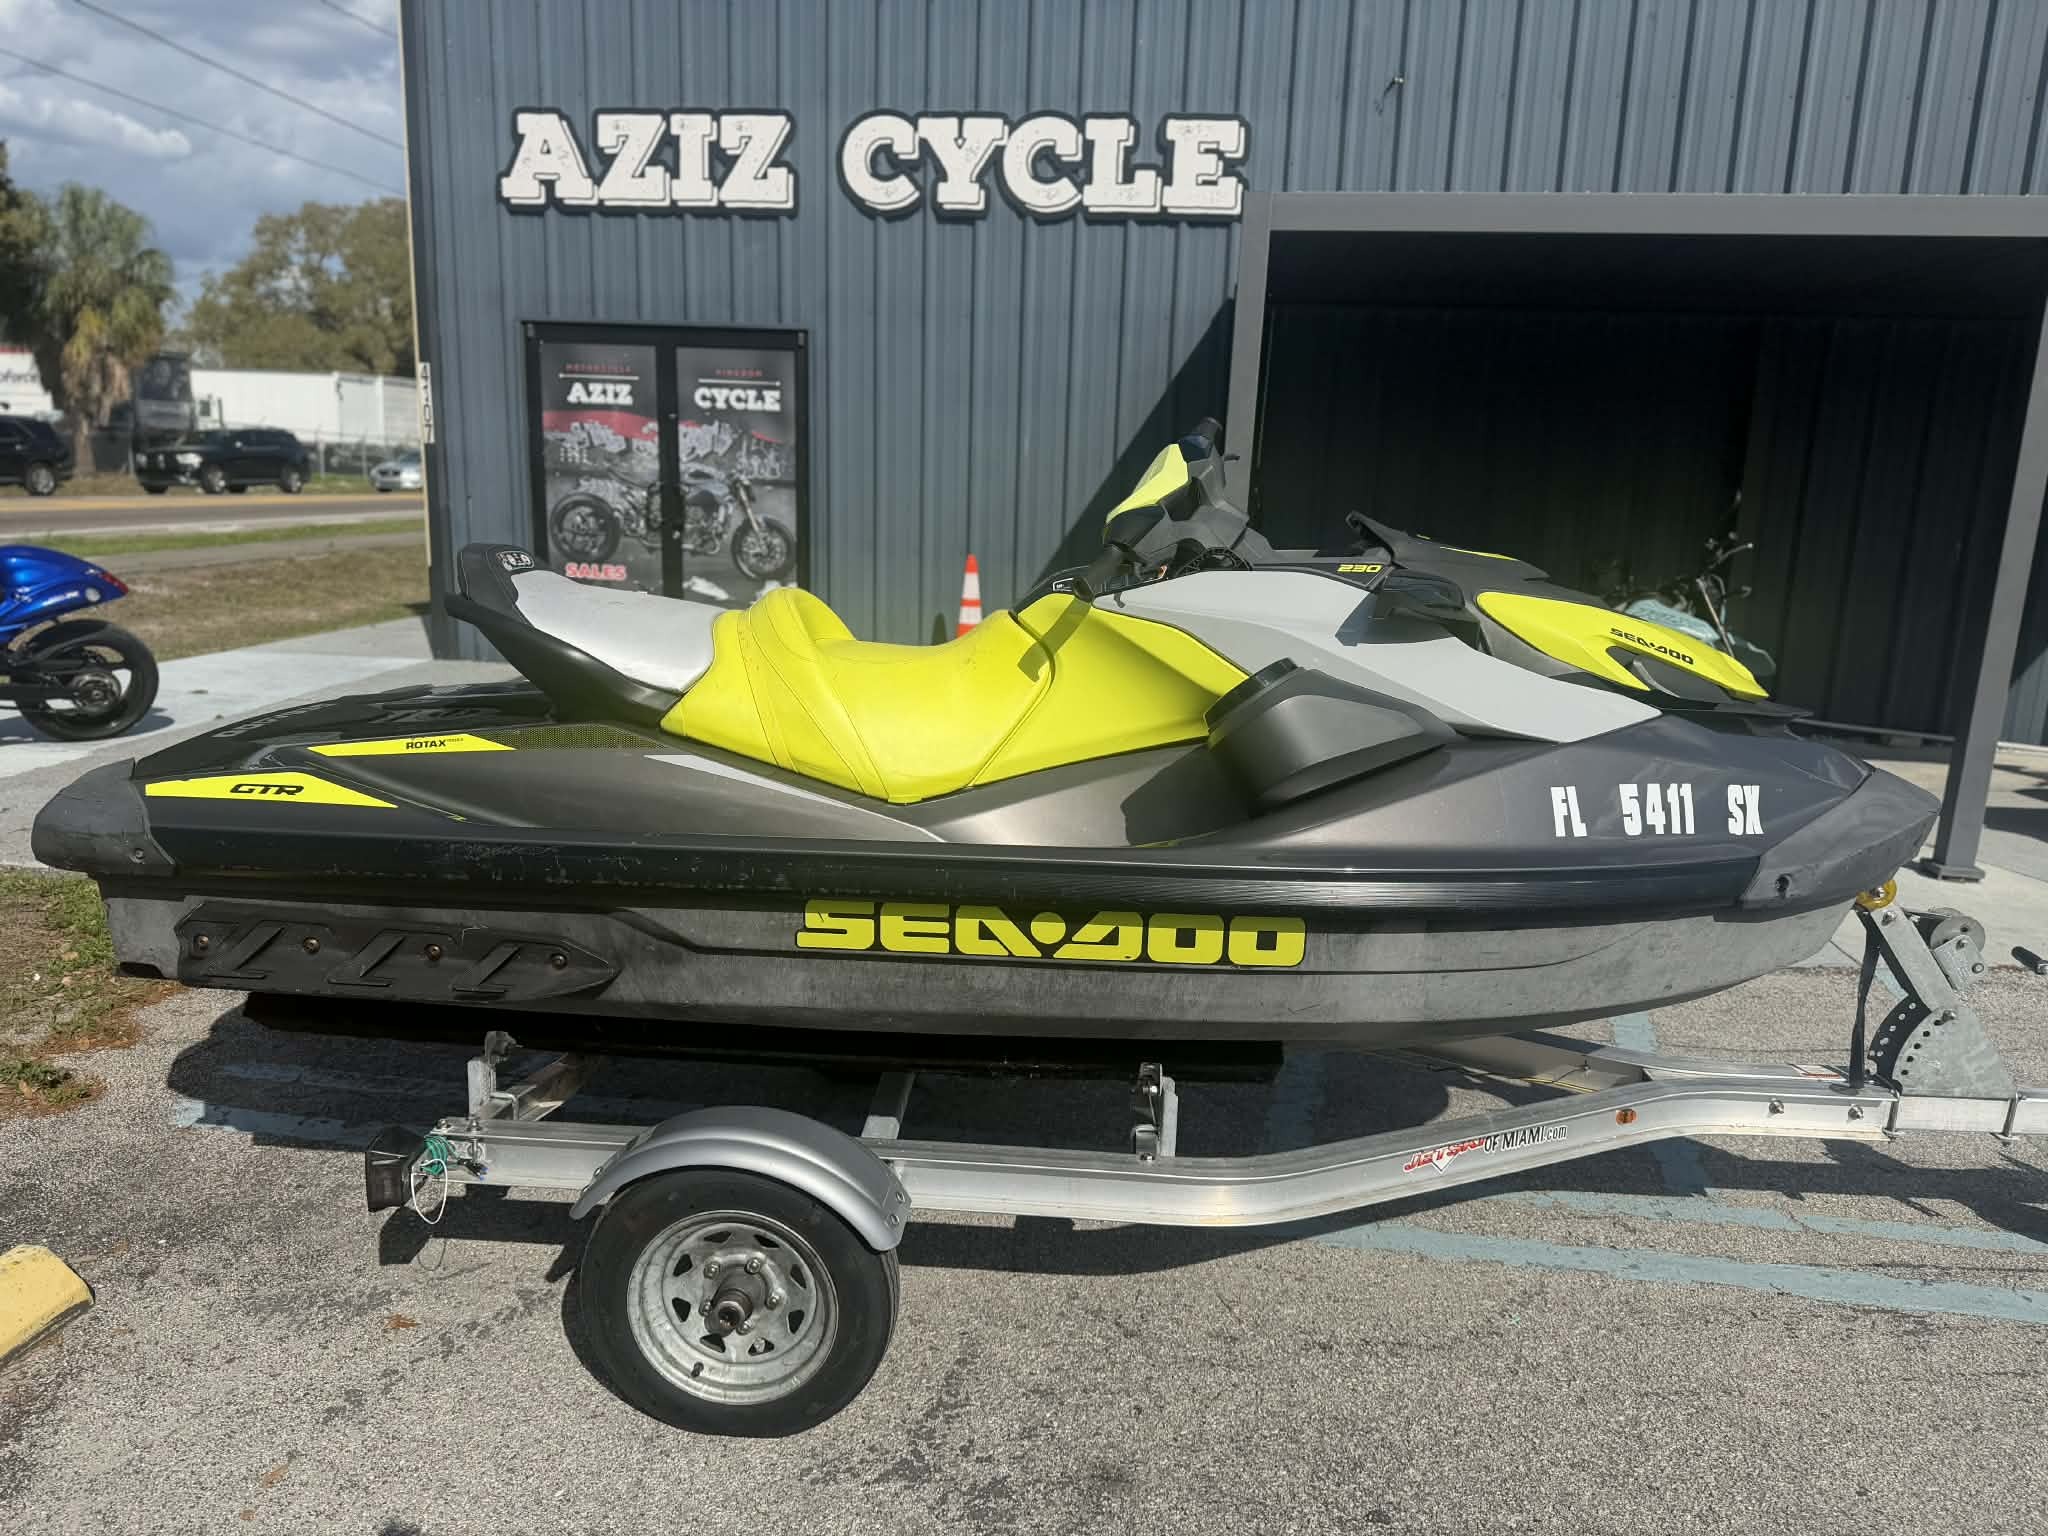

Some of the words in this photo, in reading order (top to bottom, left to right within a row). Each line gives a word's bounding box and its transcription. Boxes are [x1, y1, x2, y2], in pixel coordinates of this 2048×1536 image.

[501, 111, 795, 209] AZIZ
[841, 115, 1246, 216] CYCLE
[566, 382, 634, 405] AZIZ
[694, 387, 781, 412] CYCLE
[565, 562, 627, 581] SALES
[1336, 563, 1382, 574] 230
[405, 739, 447, 750] ROTAX
[230, 783, 305, 796] GTR
[1550, 785, 1588, 838] FL
[1618, 782, 1696, 837] 5411
[1727, 783, 1765, 837] SX
[1484, 1136, 1500, 1153] OF
[1502, 1125, 1568, 1150] MIAMI.com
